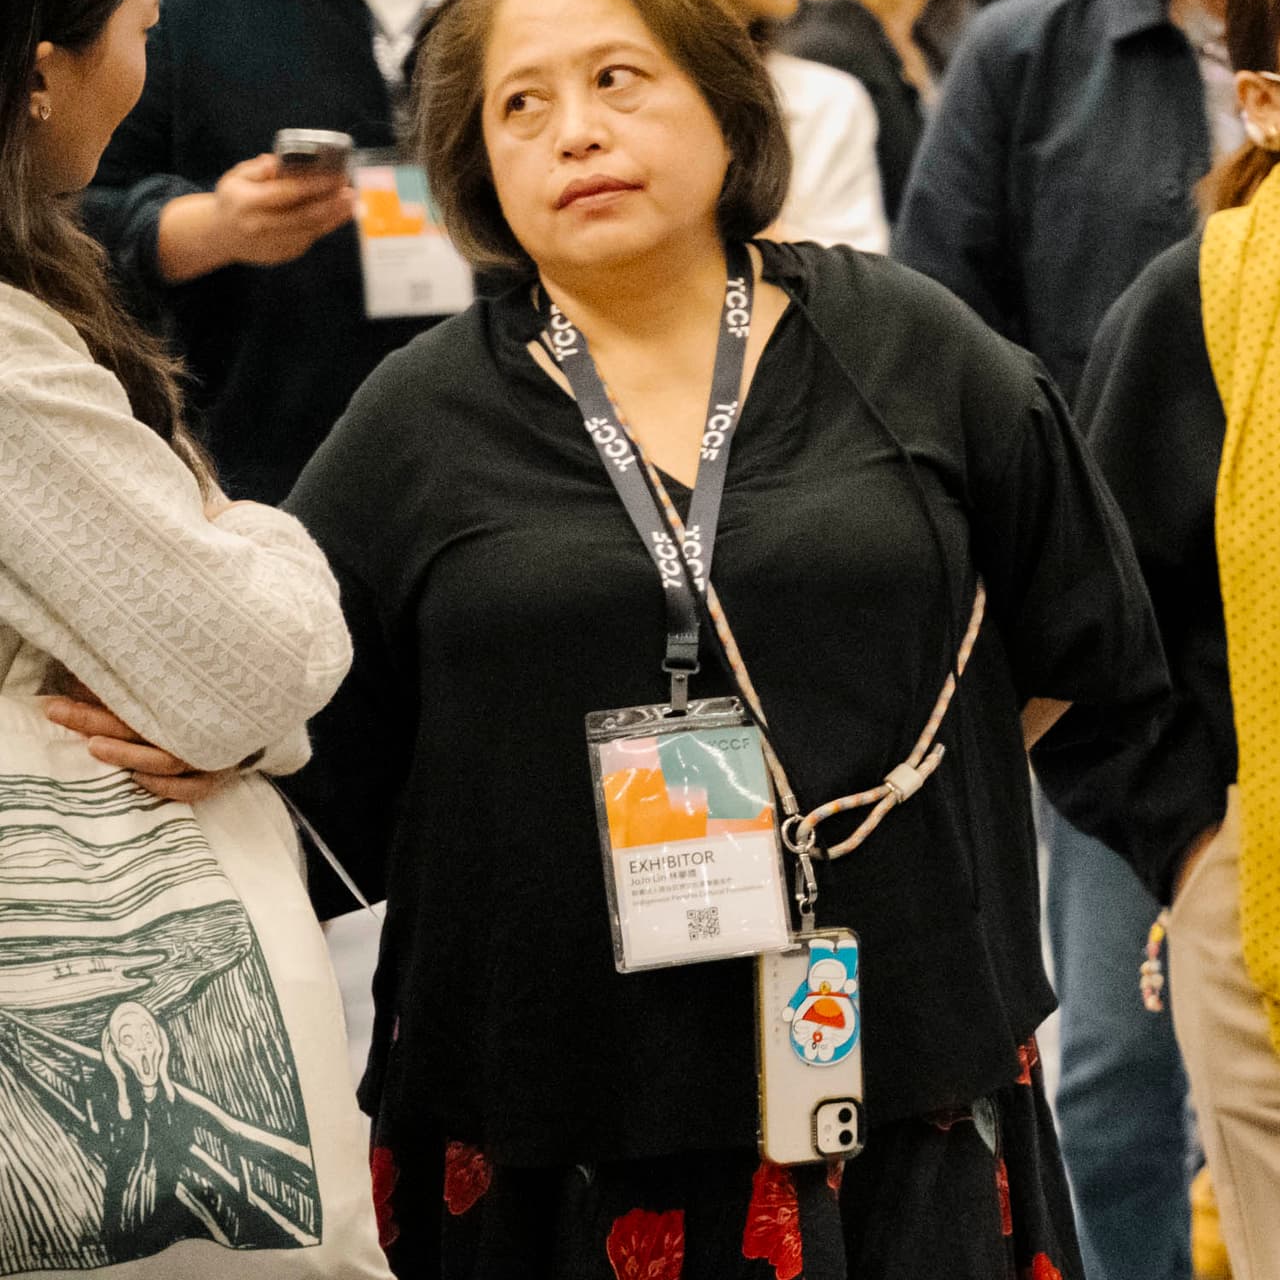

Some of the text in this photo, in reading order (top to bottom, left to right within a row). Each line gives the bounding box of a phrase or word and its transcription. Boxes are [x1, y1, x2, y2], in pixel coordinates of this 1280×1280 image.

[724, 277, 750, 340] TCCF
[584, 416, 637, 472] TCCF
[700, 400, 738, 462] TCCF
[651, 531, 683, 589] TCCF
[629, 850, 716, 875] EXHIBITOR
